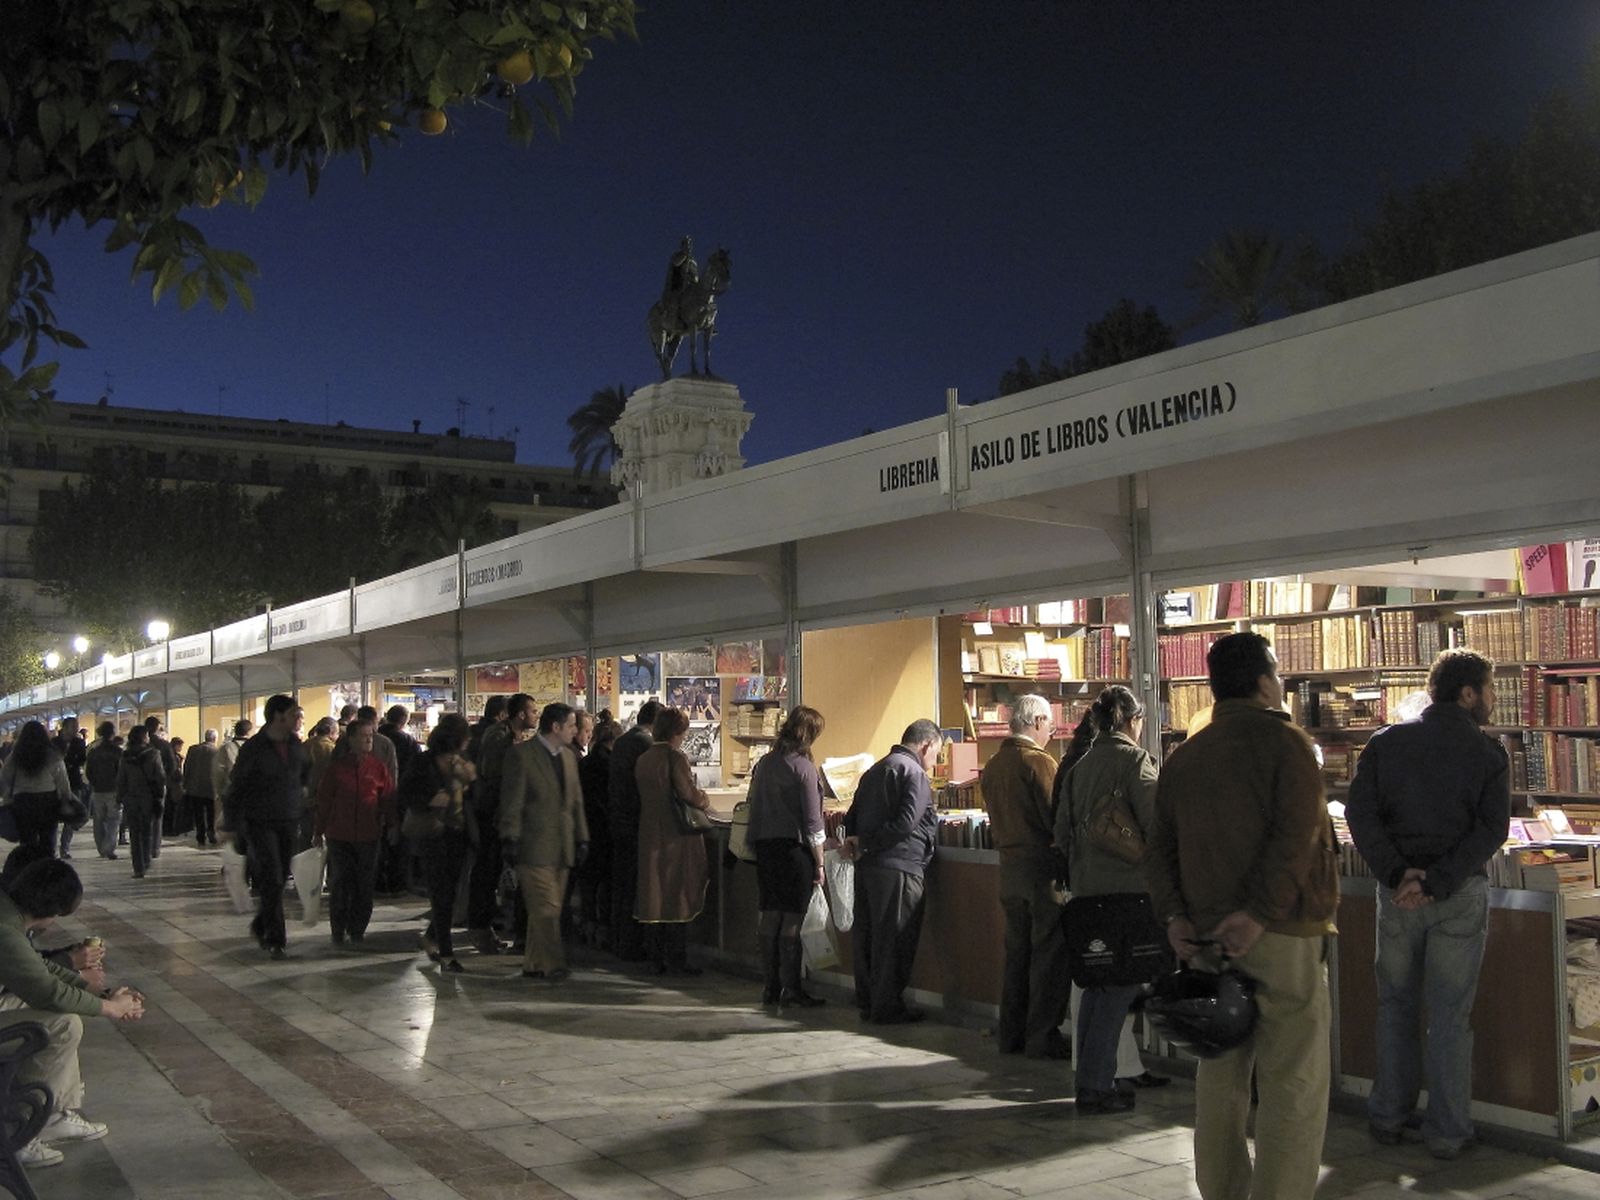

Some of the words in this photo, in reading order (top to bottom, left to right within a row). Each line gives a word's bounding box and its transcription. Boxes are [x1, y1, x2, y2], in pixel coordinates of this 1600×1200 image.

[880, 456, 939, 493] LIBRERIA
[971, 437, 1015, 472] ASILO
[1020, 430, 1041, 458] DE
[1047, 414, 1109, 454] LIBROS
[1116, 382, 1236, 438] (VALENCIA)
[1525, 544, 1547, 570] SPEED
